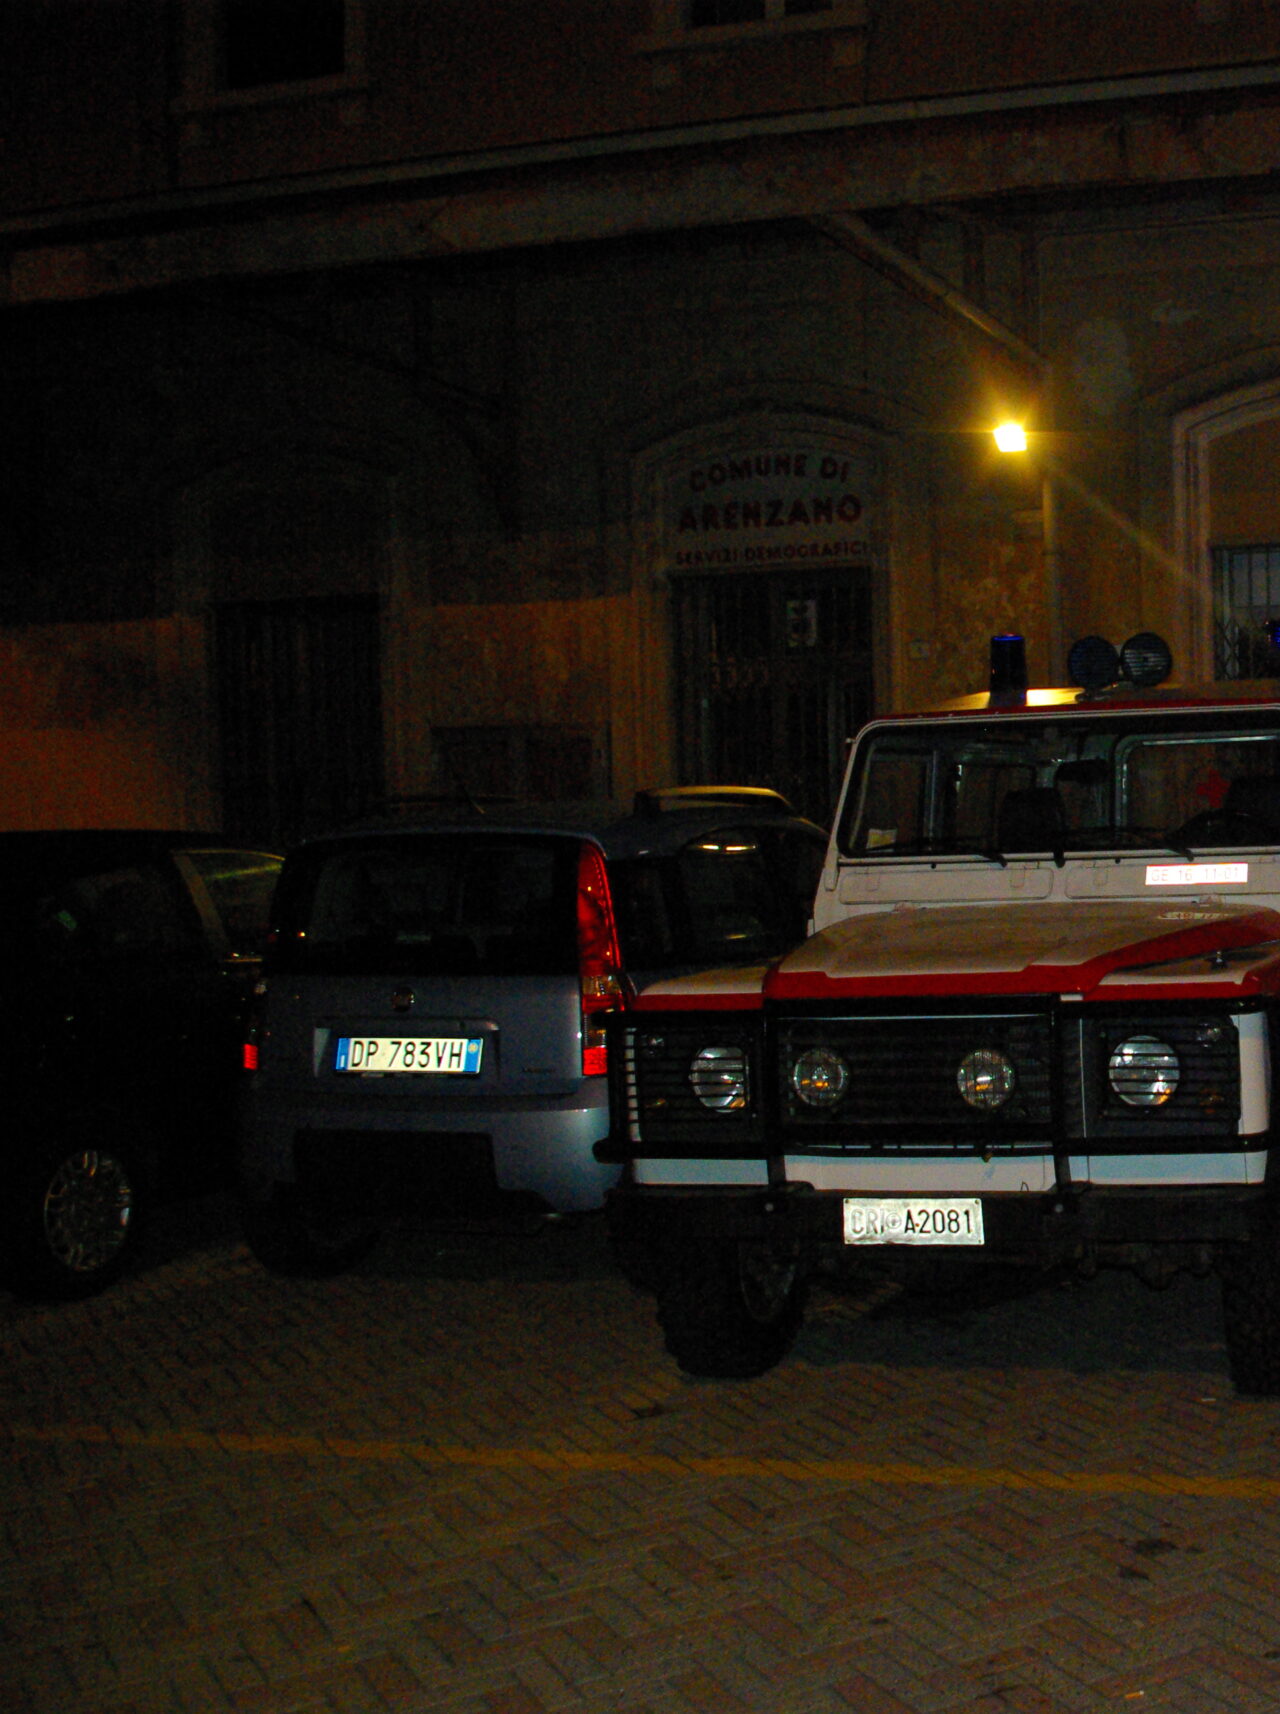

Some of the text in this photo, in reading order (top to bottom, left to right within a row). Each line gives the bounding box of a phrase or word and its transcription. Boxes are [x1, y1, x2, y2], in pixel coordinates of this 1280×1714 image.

[688, 453, 850, 492] COMUNE DI
[678, 493, 862, 534] ARENZANO
[675, 540, 868, 566] SERVIZI DEMOGRAFICI
[351, 1040, 379, 1068] DP
[388, 1040, 464, 1069] 783VH
[850, 1208, 886, 1235] CRI
